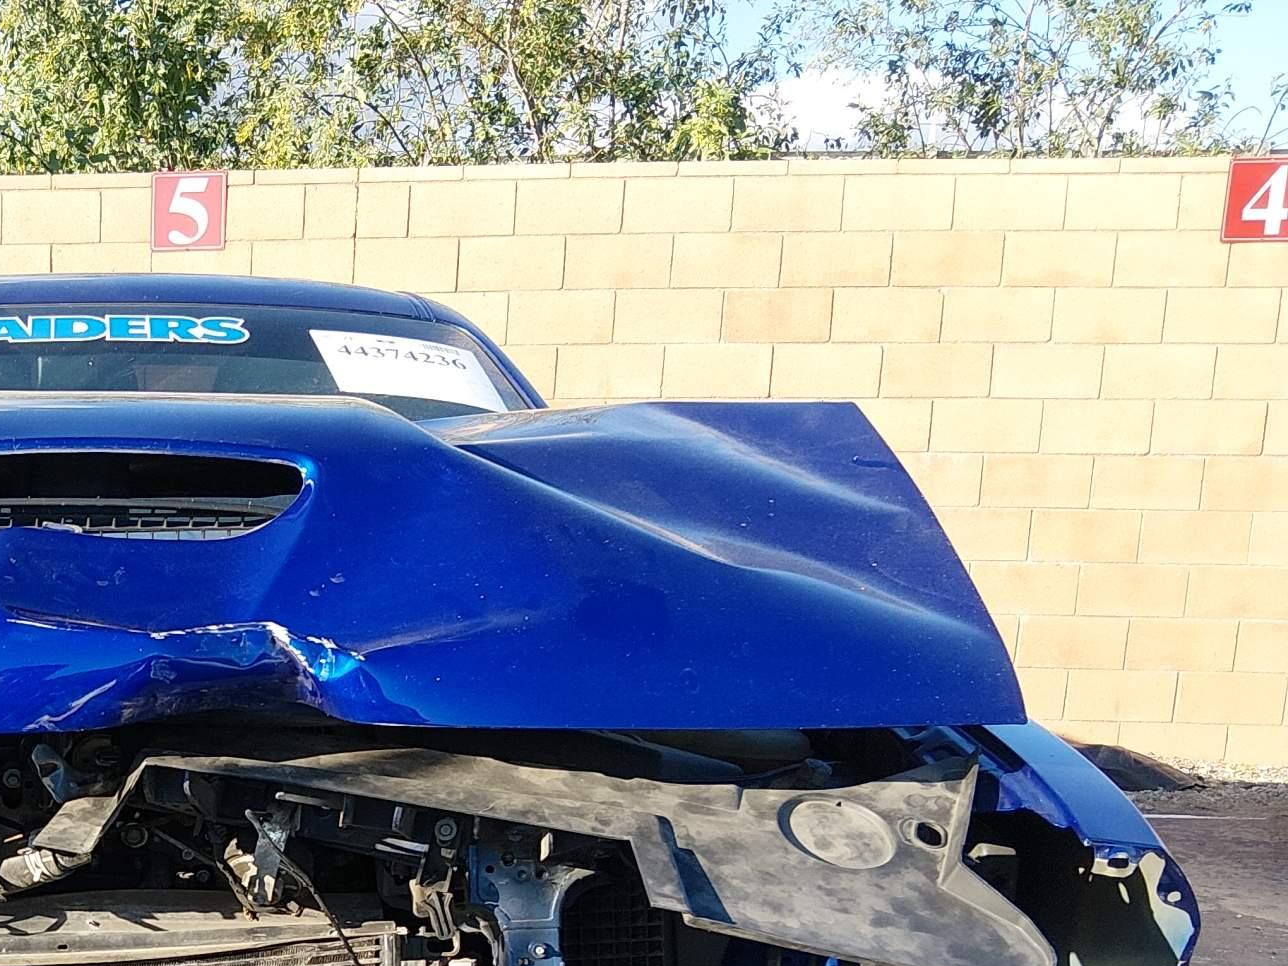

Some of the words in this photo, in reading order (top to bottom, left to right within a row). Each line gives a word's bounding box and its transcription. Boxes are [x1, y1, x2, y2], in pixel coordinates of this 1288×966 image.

[168, 177, 209, 246] 5
[1241, 164, 1288, 236] 4
[337, 344, 467, 370] 44374236
